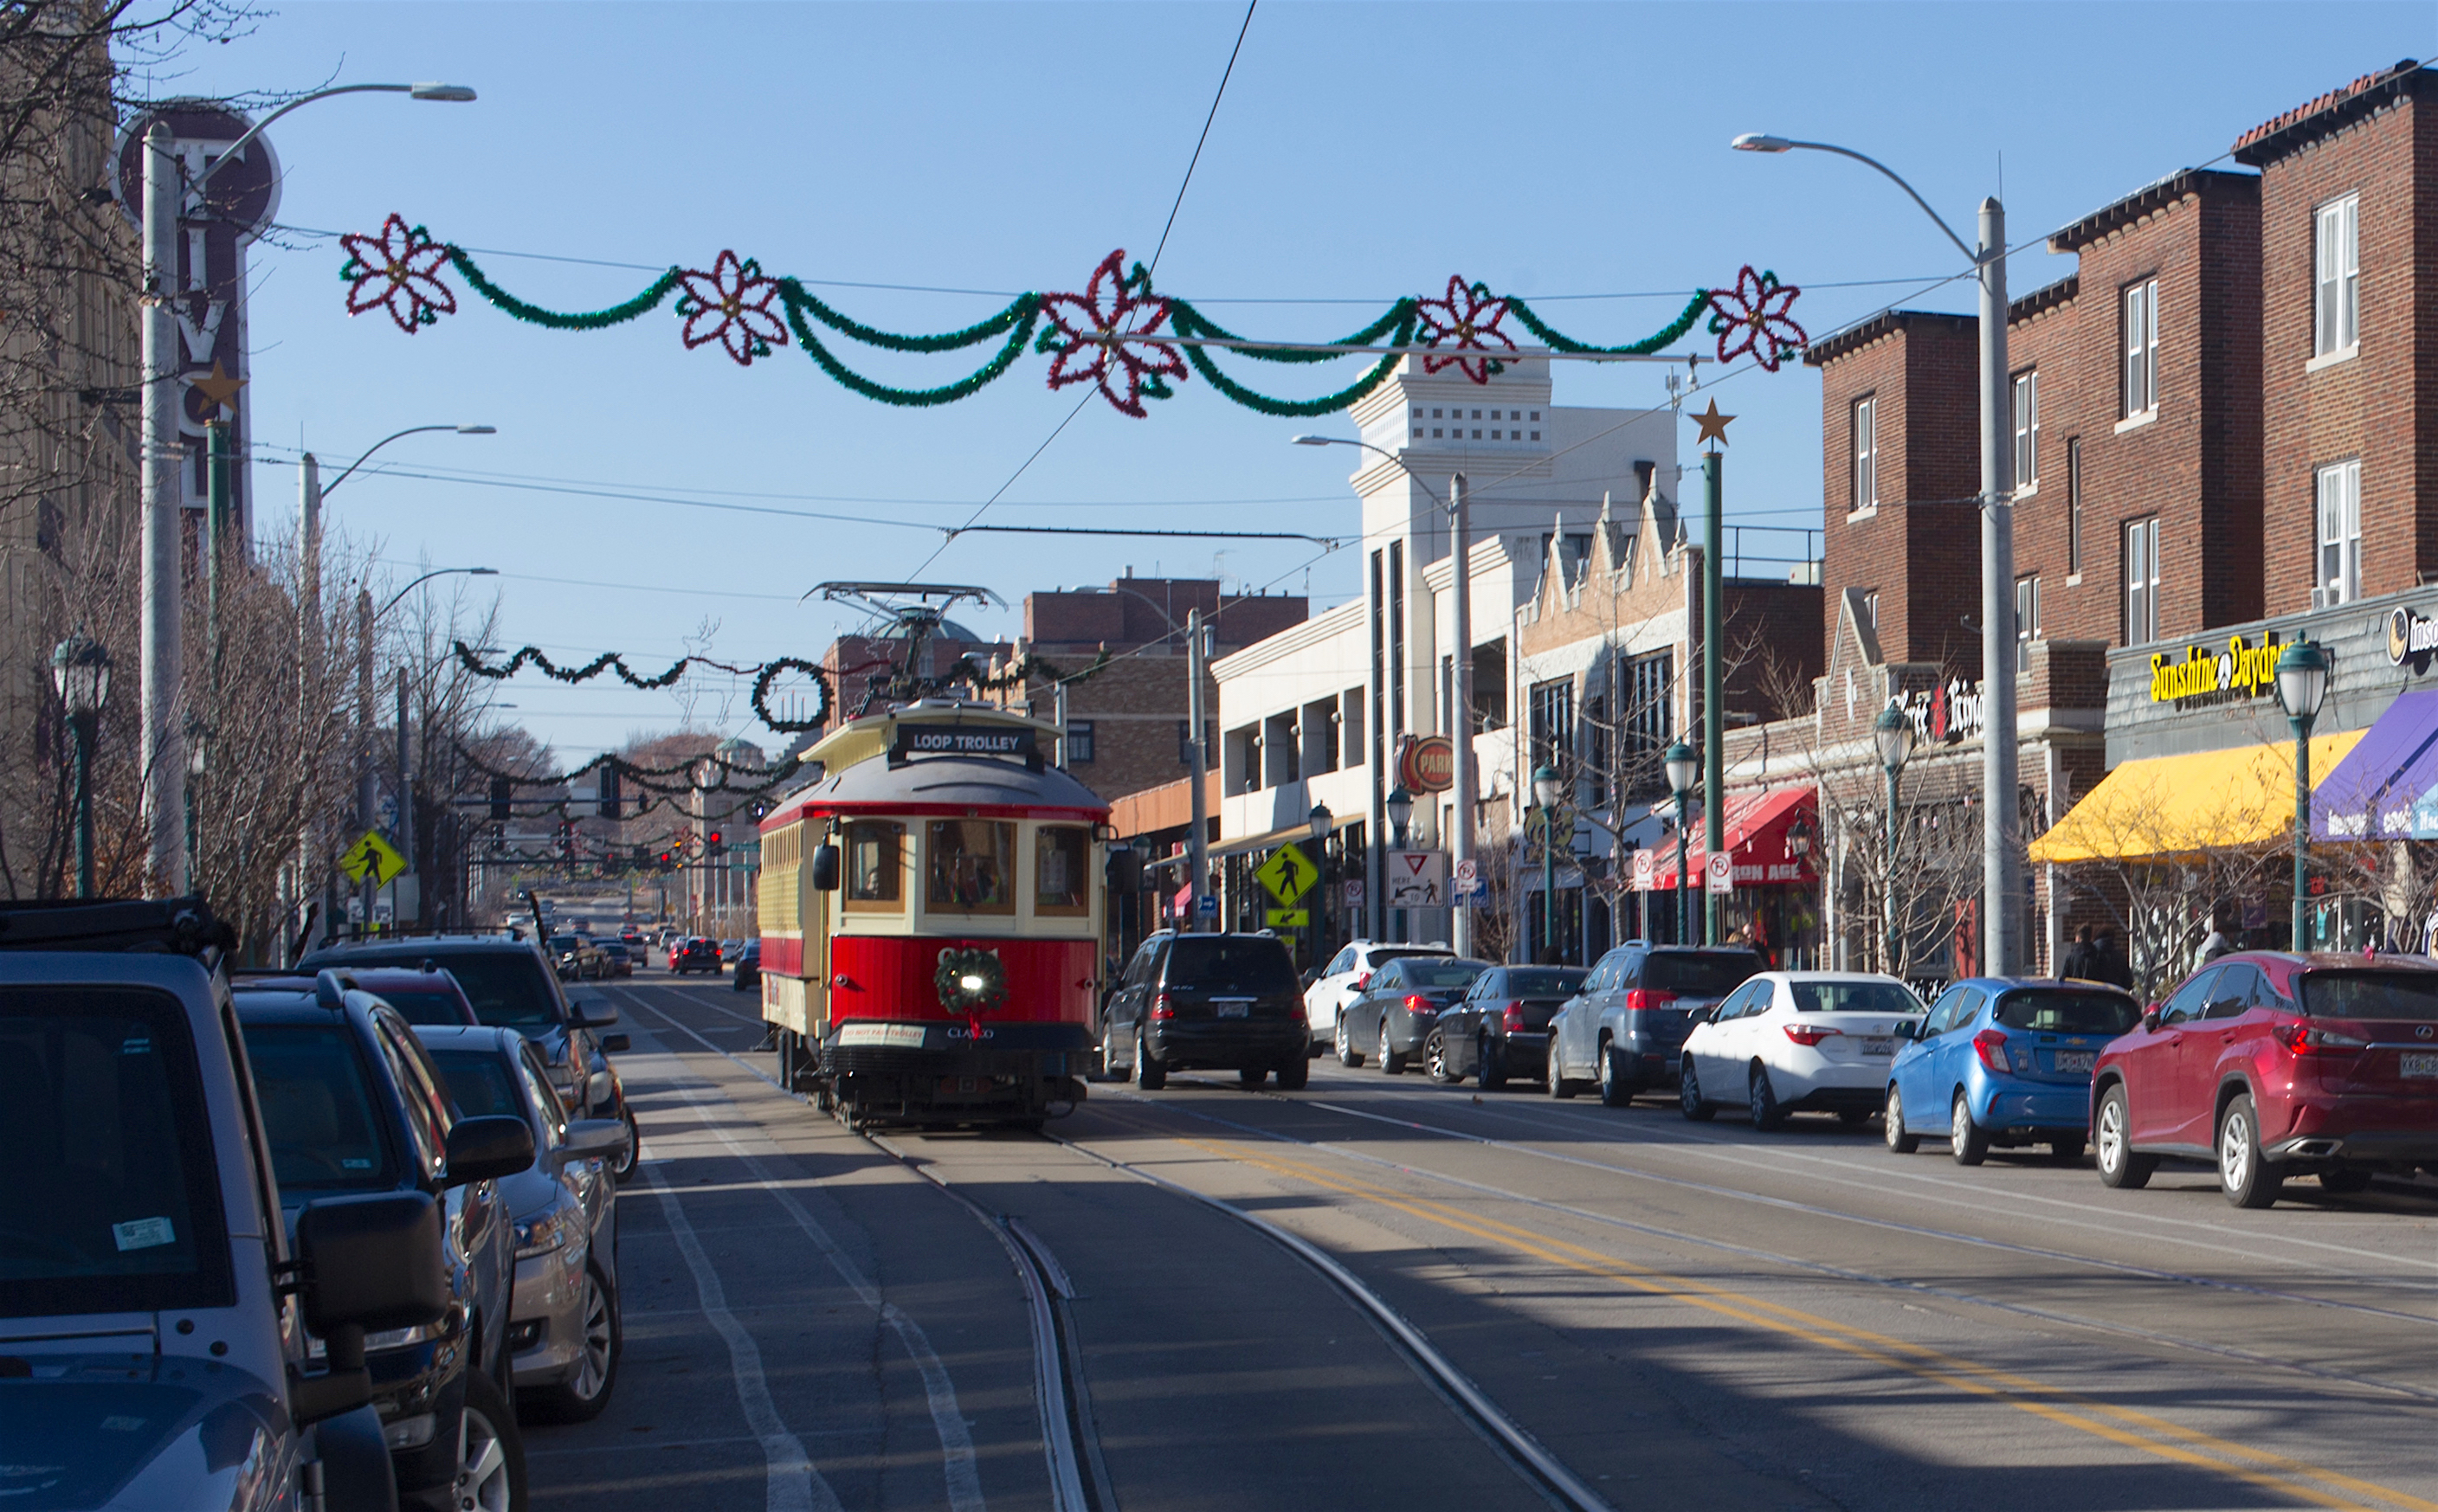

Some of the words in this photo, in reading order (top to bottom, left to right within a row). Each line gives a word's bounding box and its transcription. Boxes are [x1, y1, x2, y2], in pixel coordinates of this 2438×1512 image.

[2151, 645, 2219, 703] Sunshine
[2229, 630, 2309, 698] Daydr
[914, 735, 951, 749] LOOP
[955, 736, 1019, 750] TROLLEY
[1768, 864, 1801, 880] AGE
